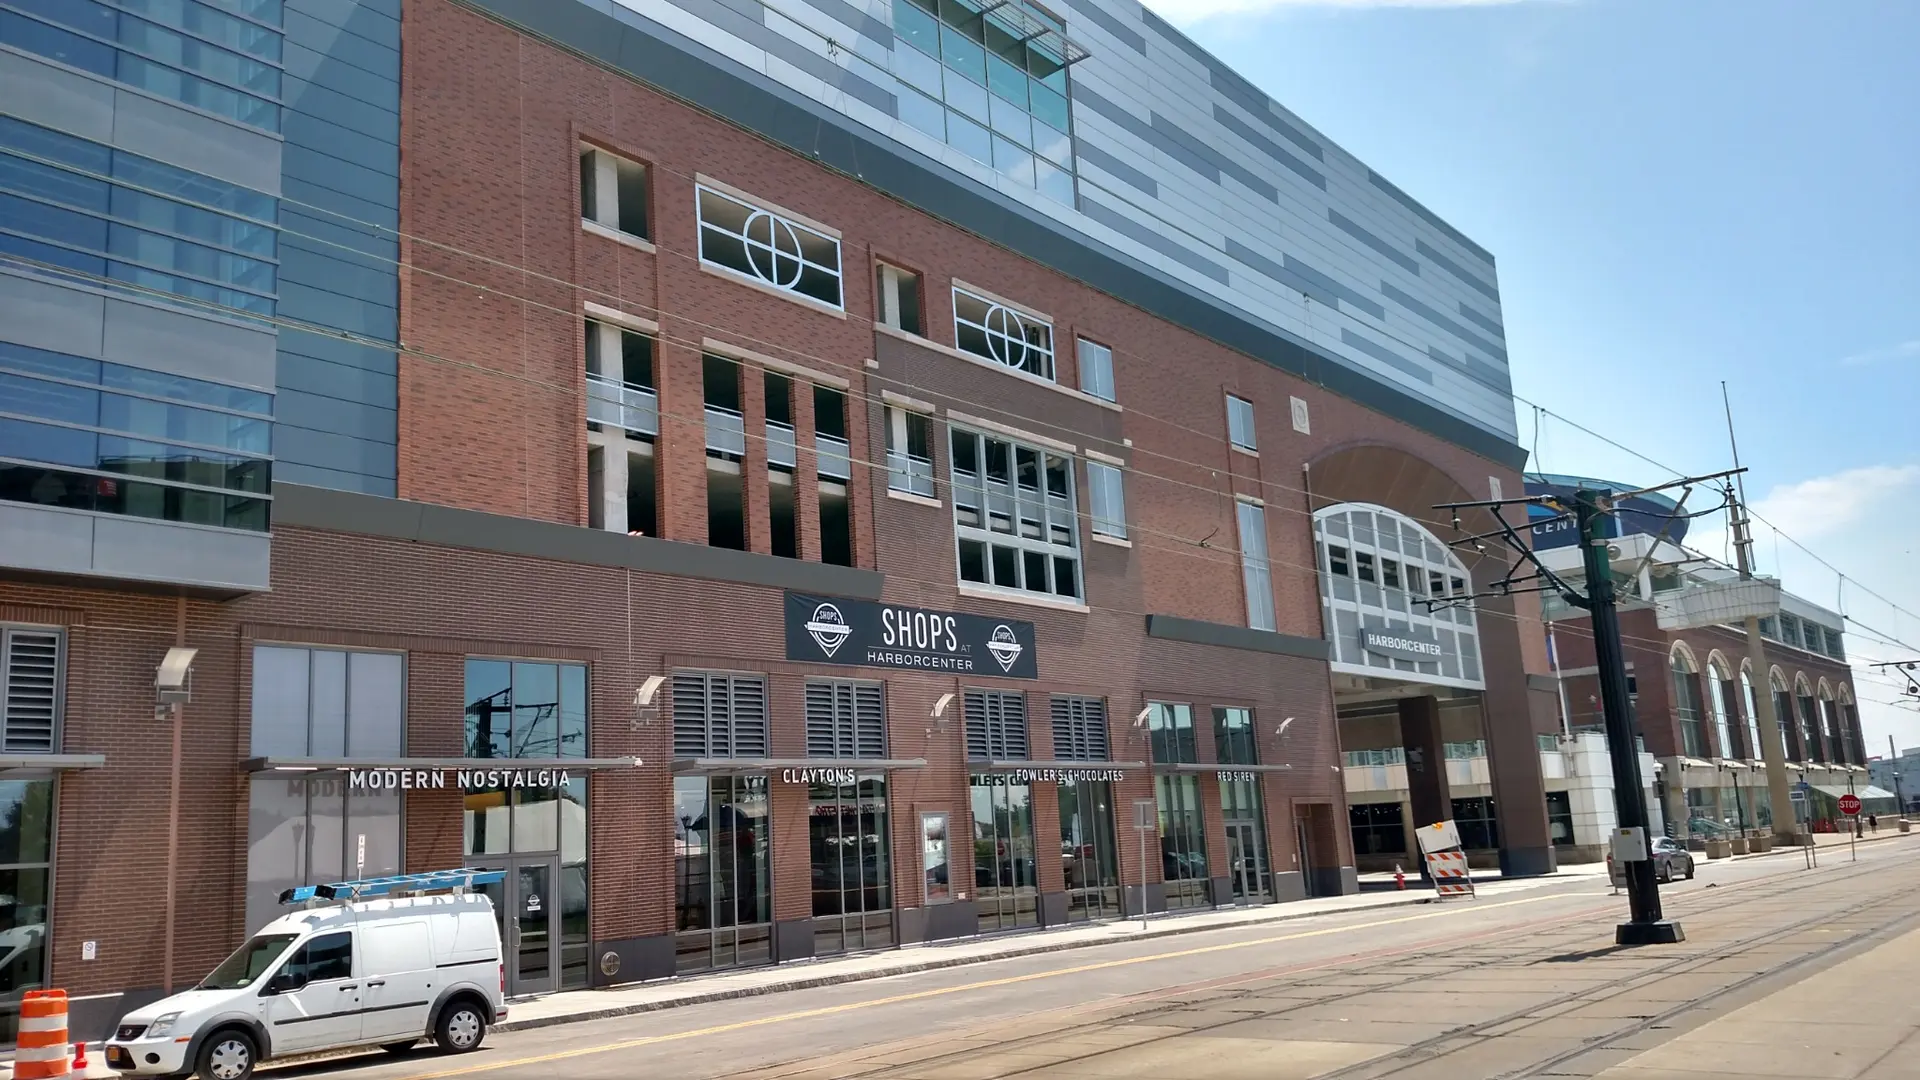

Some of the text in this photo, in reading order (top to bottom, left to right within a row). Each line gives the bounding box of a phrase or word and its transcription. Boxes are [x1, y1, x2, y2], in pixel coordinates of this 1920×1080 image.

[819, 610, 838, 621] SHOPS
[882, 608, 972, 653] SHOPS AT
[1368, 633, 1442, 656] HARBORCENTER
[867, 651, 973, 670] HARBORCENTER
[350, 770, 445, 789] MODERN
[457, 770, 571, 788] NOSTALGIA
[783, 768, 855, 784] CLAYTON'S
[1016, 768, 1063, 781] FOWLER'S
[1068, 769, 1124, 782] CHOCOLATES
[1217, 771, 1255, 782] RED SIREN
[1839, 800, 1860, 809] STOP
